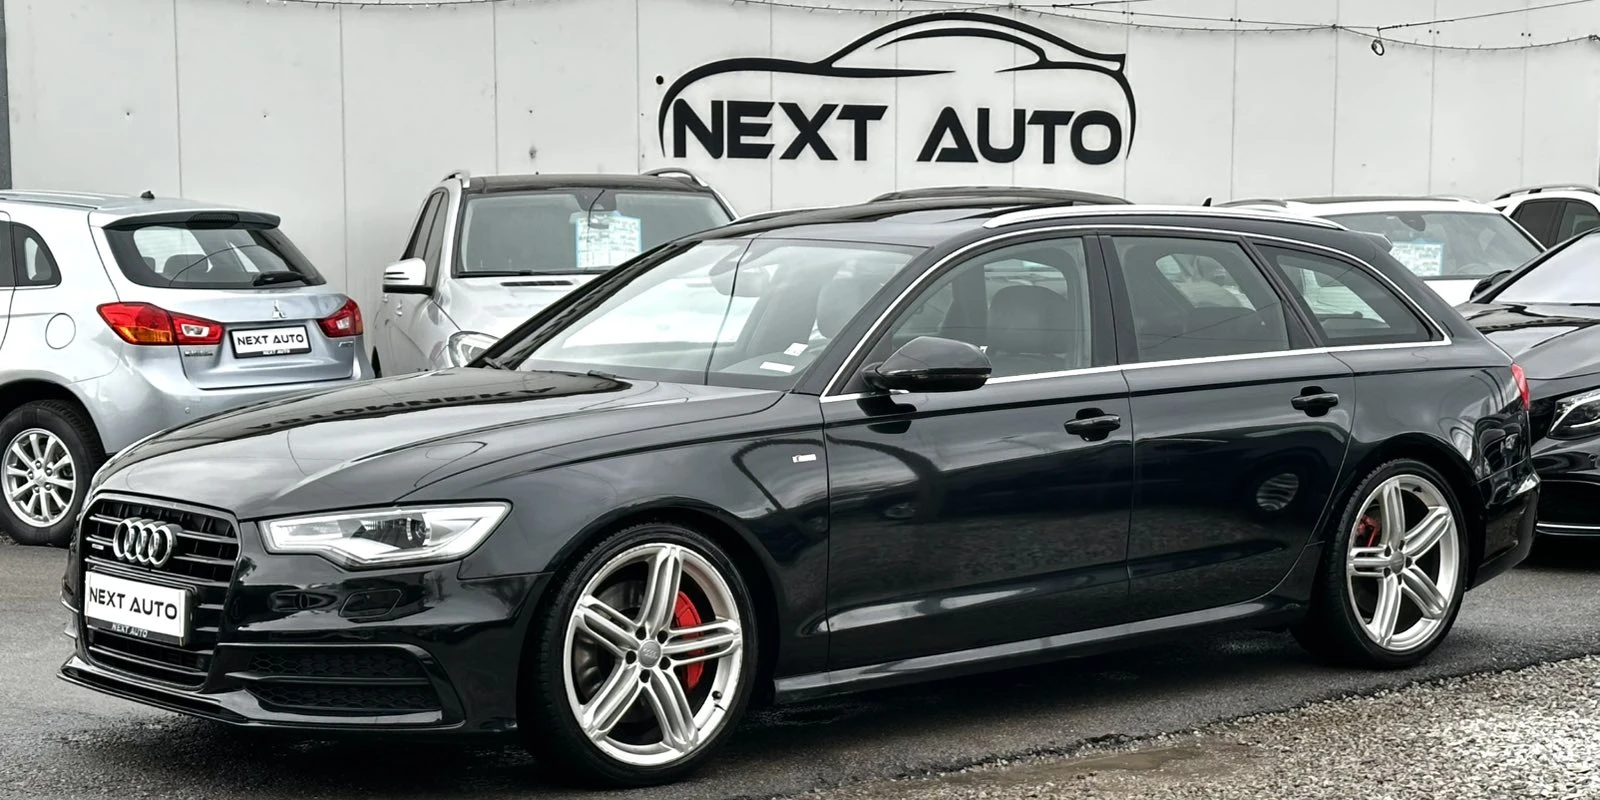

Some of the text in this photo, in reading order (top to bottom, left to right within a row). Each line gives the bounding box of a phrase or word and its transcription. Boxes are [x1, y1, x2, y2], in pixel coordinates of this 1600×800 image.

[673, 98, 1122, 165] NEXT AUTO
[237, 333, 304, 346] NEXT AUTO
[90, 587, 177, 620] NEXT AUTO
[112, 623, 148, 638] NEXT AUTO
